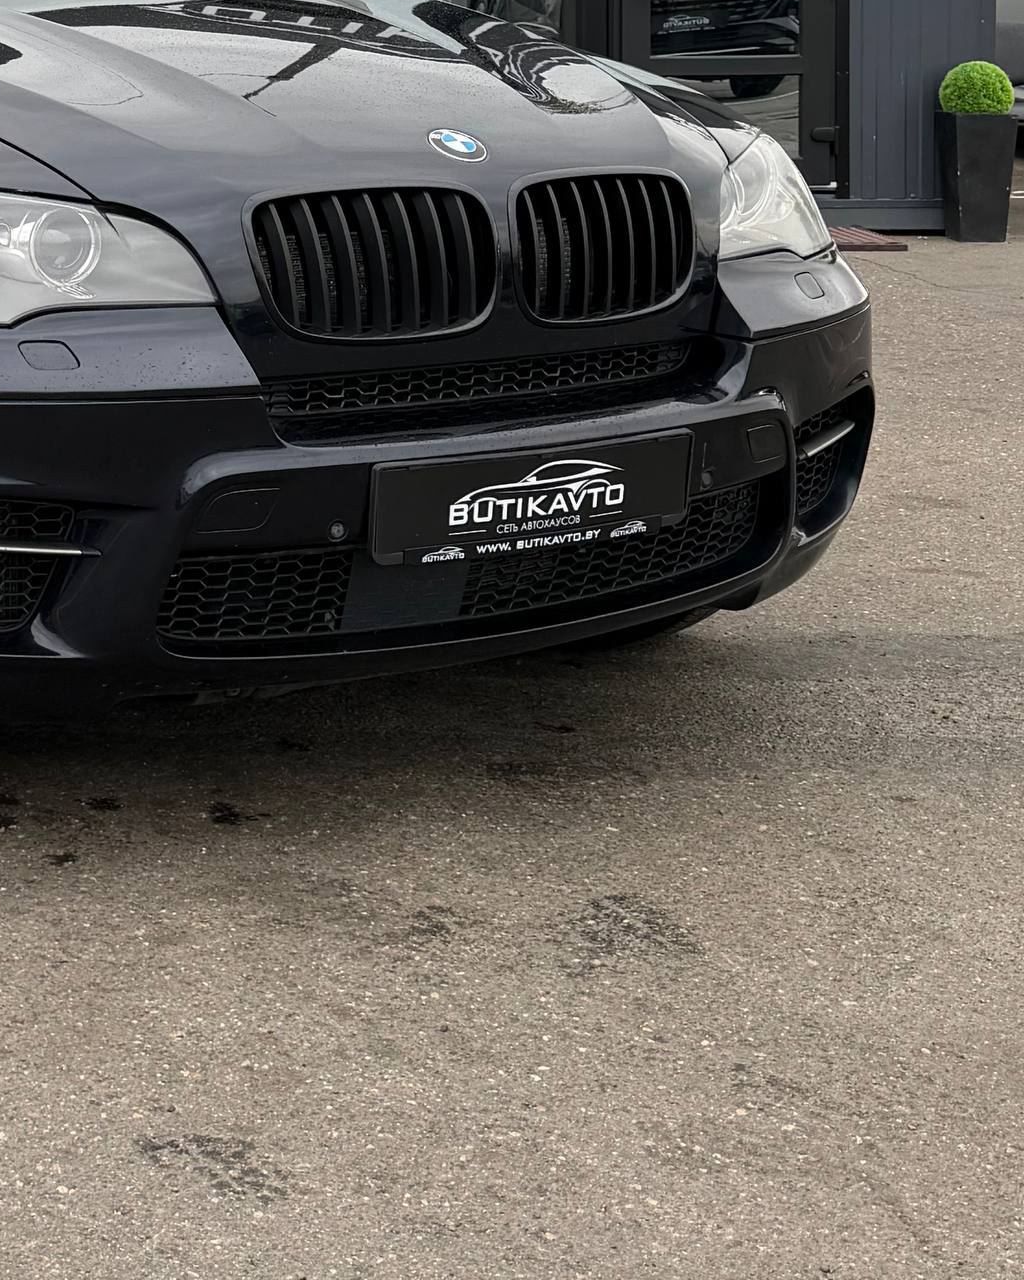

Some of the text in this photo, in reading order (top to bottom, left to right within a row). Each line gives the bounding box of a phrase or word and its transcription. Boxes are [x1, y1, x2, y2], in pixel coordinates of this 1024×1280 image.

[448, 483, 625, 526] BUTIKAVTO
[496, 515, 581, 534] СЕТЬ АВТОХАУСОВ
[516, 529, 601, 549] BUTIKAVTO.BY
